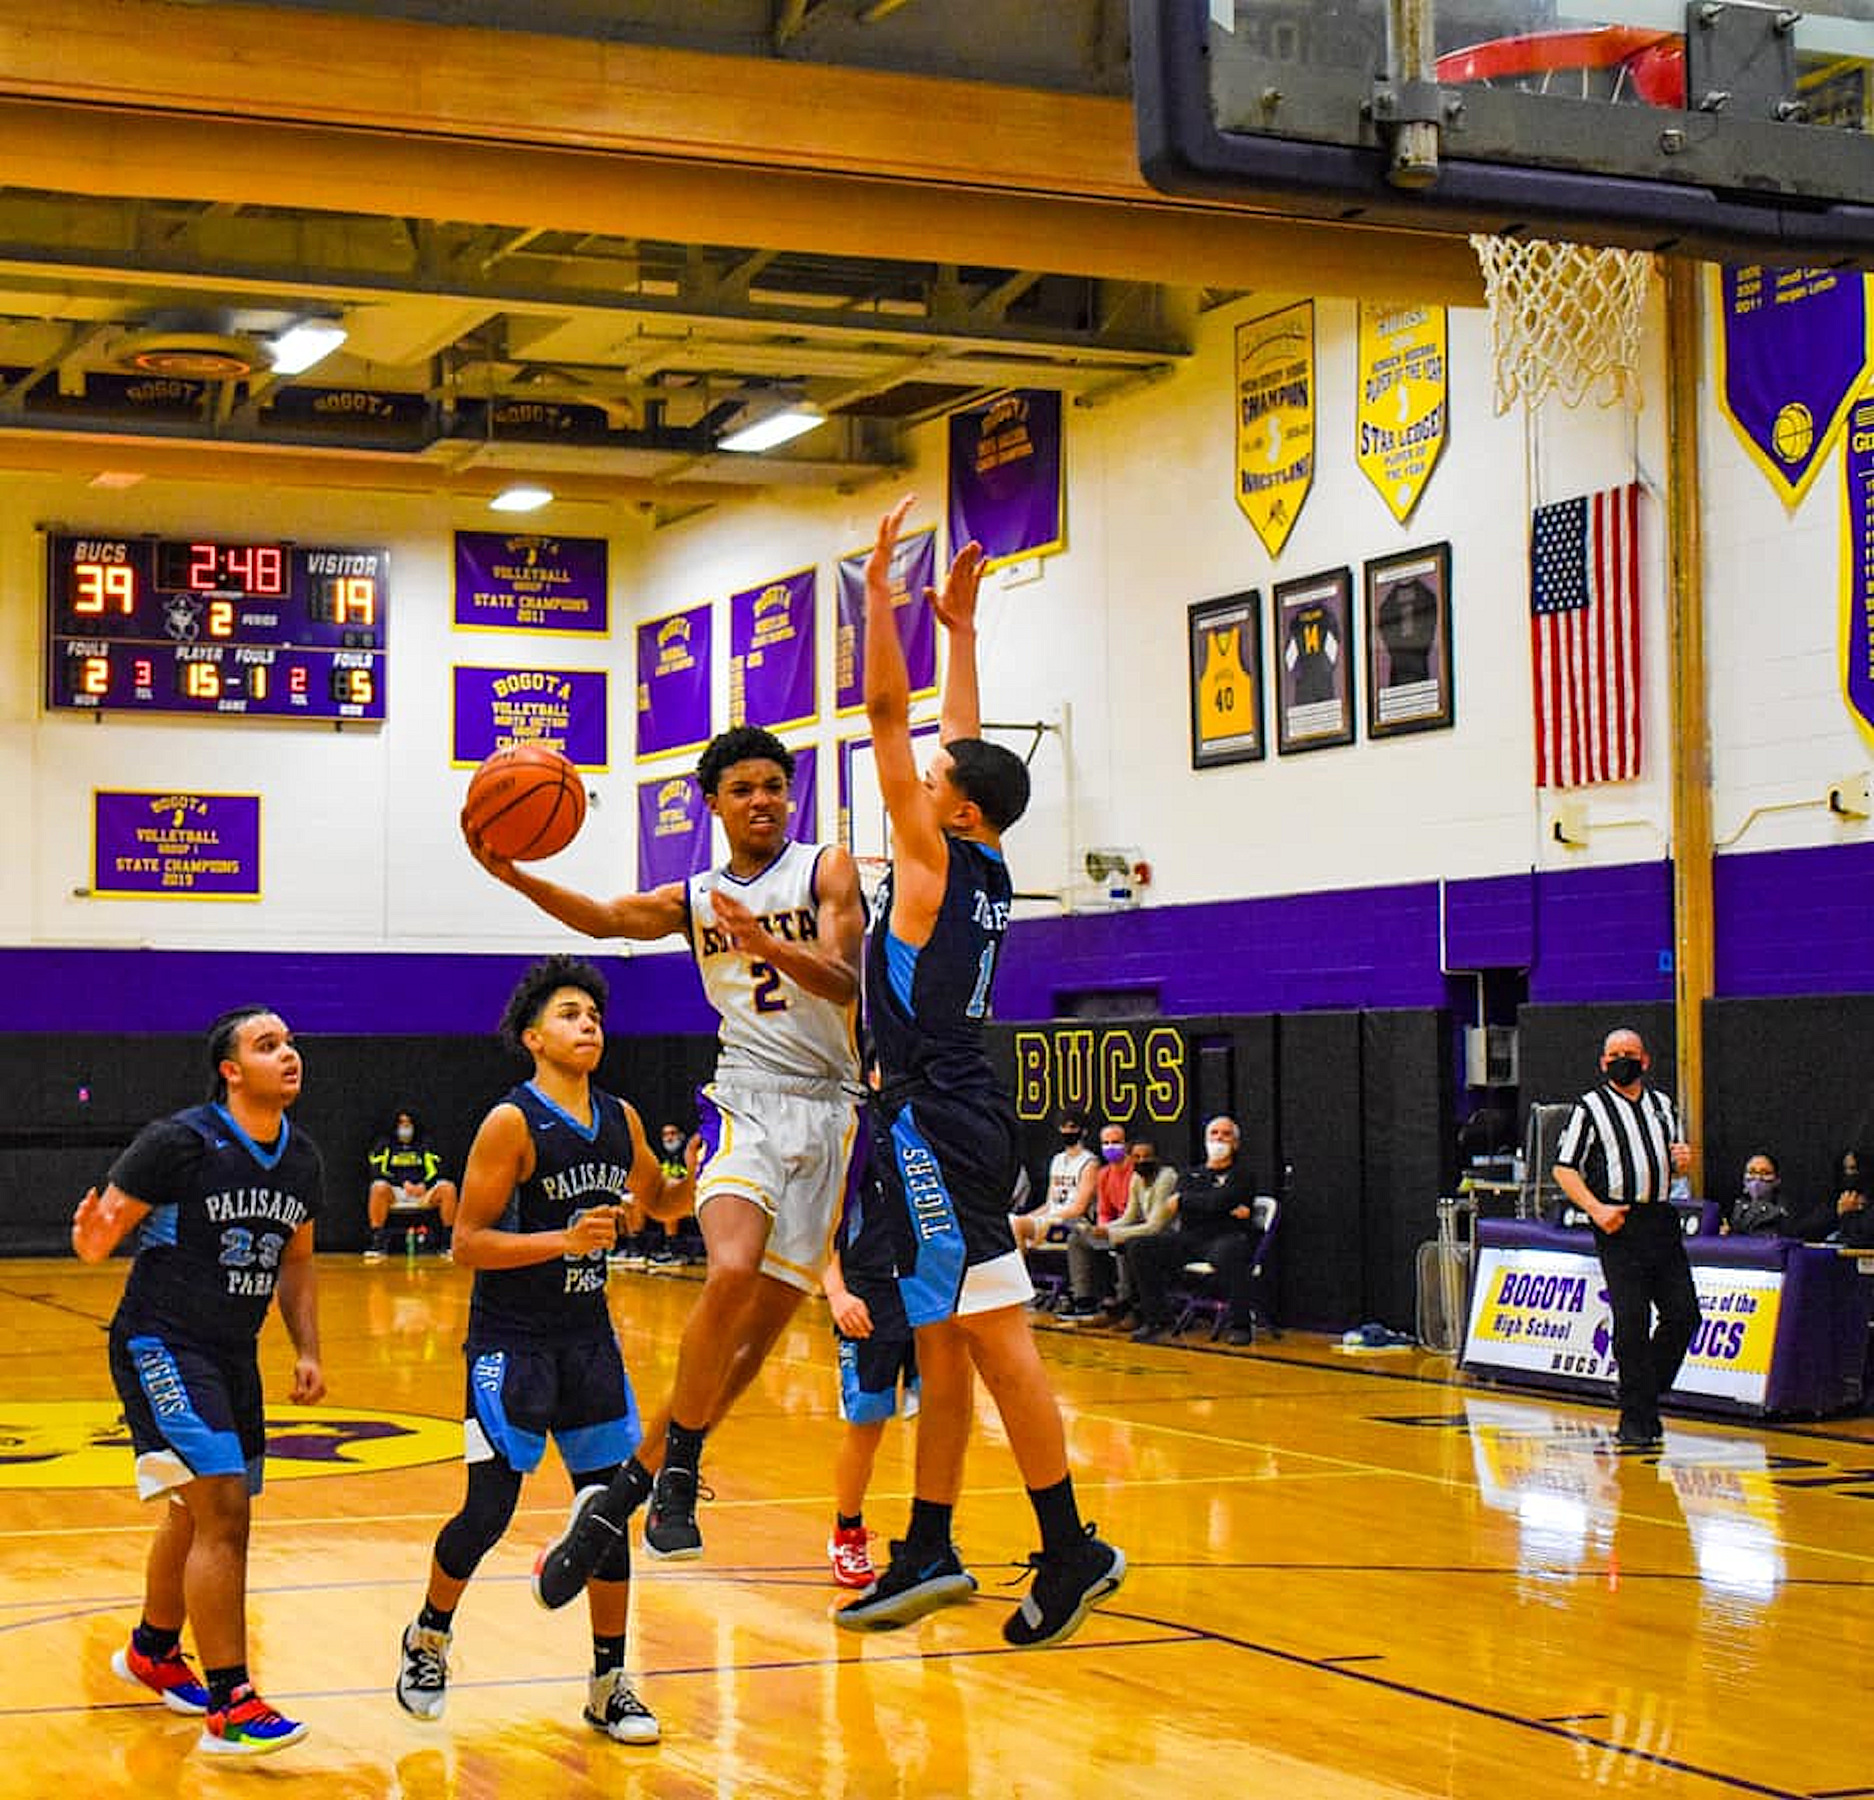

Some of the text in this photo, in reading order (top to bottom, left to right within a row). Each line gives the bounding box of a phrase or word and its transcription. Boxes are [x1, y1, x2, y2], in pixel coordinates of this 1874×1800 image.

[74, 543, 125, 563] BUCS
[307, 553, 376, 576] VISITOR
[191, 545, 281, 591] 2:48
[74, 564, 134, 613] 39
[334, 577, 374, 625] 19
[473, 592, 515, 608] STATE
[209, 601, 233, 636] 2
[67, 641, 109, 657] FOULS
[176, 646, 275, 664] PLAYER FOULS
[333, 653, 374, 668] FOULS
[86, 658, 109, 693] 2
[135, 661, 151, 685] 3
[188, 662, 219, 697] 15
[254, 665, 267, 699] 1
[290, 667, 307, 691] 2
[351, 670, 372, 703] 5
[492, 672, 572, 701] BOGOTA
[491, 702, 570, 717] VOLLEYBALL
[136, 828, 219, 844] VOLLEYBALL
[116, 858, 160, 872] STATE
[751, 962, 788, 1013] 2
[1015, 1028, 1185, 1122] BUCS
[903, 1147, 952, 1240] TIGERS
[1498, 1272, 1588, 1313] BOGOTA
[1720, 1294, 1735, 1312] of
[1736, 1292, 1757, 1314] the
[1494, 1313, 1571, 1340] High School
[1551, 1352, 1598, 1375] BUCS
